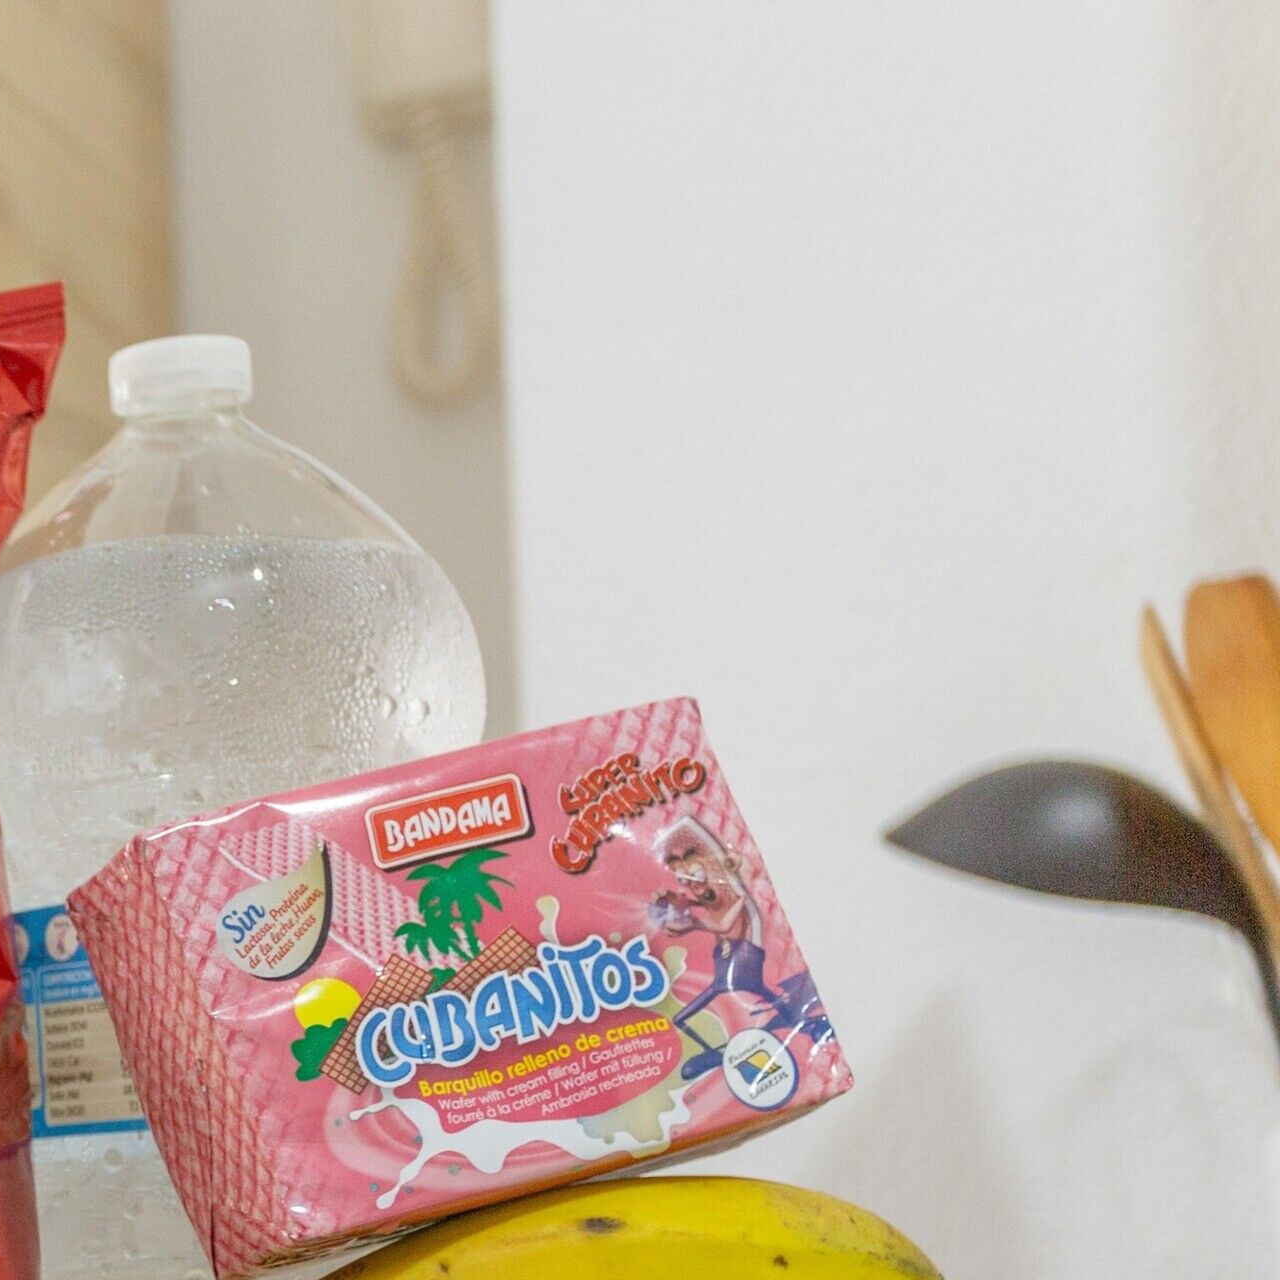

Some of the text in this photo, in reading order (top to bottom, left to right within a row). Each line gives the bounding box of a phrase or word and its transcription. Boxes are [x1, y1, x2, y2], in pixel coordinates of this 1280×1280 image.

[558, 752, 641, 815] SUPER
[383, 792, 513, 852] BANDAMA
[550, 755, 706, 874] CUBANITO
[222, 904, 266, 944] Sin
[294, 914, 316, 941] secos
[248, 954, 261, 969] de
[259, 943, 273, 956] la
[418, 1017, 669, 1097] Barquillo relleno de crema
[438, 1092, 477, 1110] Wafer
[478, 1083, 505, 1104] with
[507, 1076, 547, 1098] cream
[547, 1061, 581, 1086] filling
[589, 1037, 655, 1064] Gaufrettes
[446, 1108, 485, 1126] fourré
[497, 1099, 511, 1116] la
[561, 1071, 599, 1092] Wafer
[601, 1064, 620, 1080] mit
[541, 1063, 661, 1116] Ambrosia recheada
